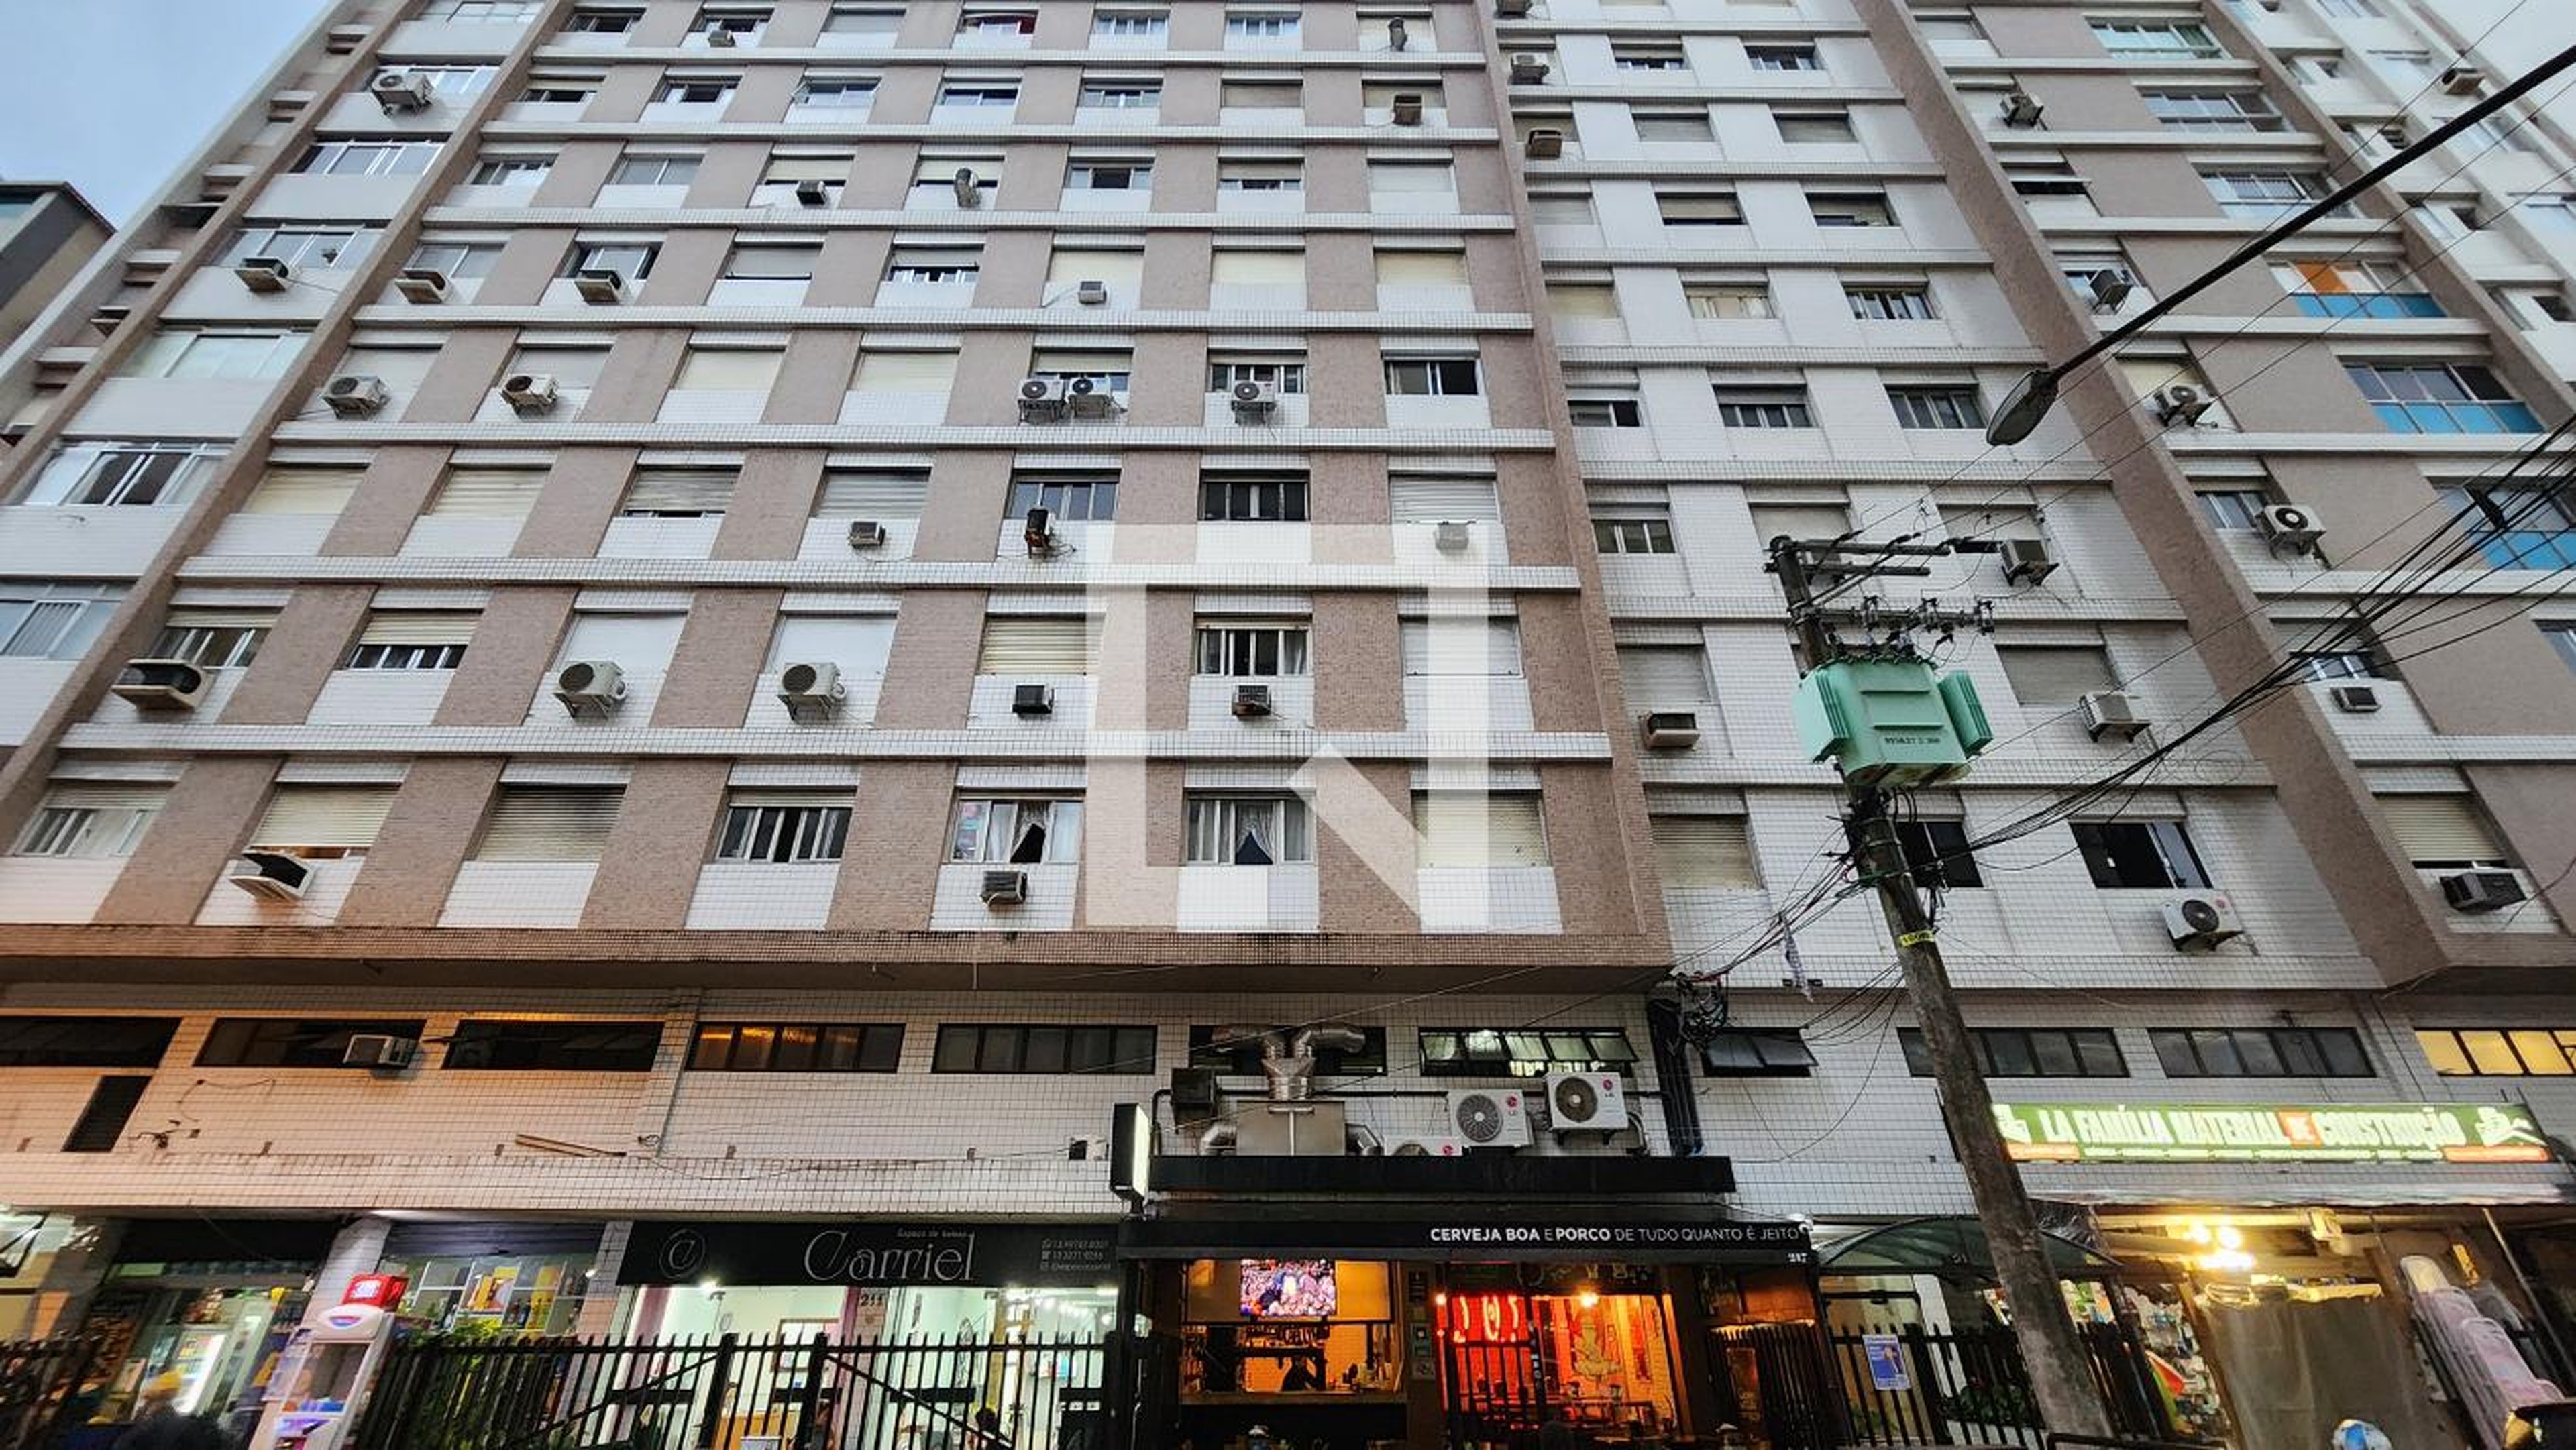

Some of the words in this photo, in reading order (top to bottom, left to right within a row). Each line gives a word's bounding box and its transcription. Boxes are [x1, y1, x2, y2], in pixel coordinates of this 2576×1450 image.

[2038, 1109, 2078, 1143] LA
[2072, 1104, 2176, 1144] FAMÍLIA
[2168, 1110, 2292, 1146] MATERIAL
[2311, 1106, 2467, 1150] CONSTRUÇÃO
[804, 1230, 975, 1281] Carriel
[1430, 1228, 1502, 1241] CERVEJA
[1505, 1228, 1541, 1241] BOA
[1544, 1229, 1554, 1241] E
[1556, 1228, 1611, 1241] PORCO
[1614, 1229, 1634, 1241] DE
[1638, 1229, 1679, 1241] TUDO
[1682, 1228, 1743, 1241] QUANTO
[1746, 1225, 1755, 1240] É
[1760, 1228, 1799, 1240] JEITO
